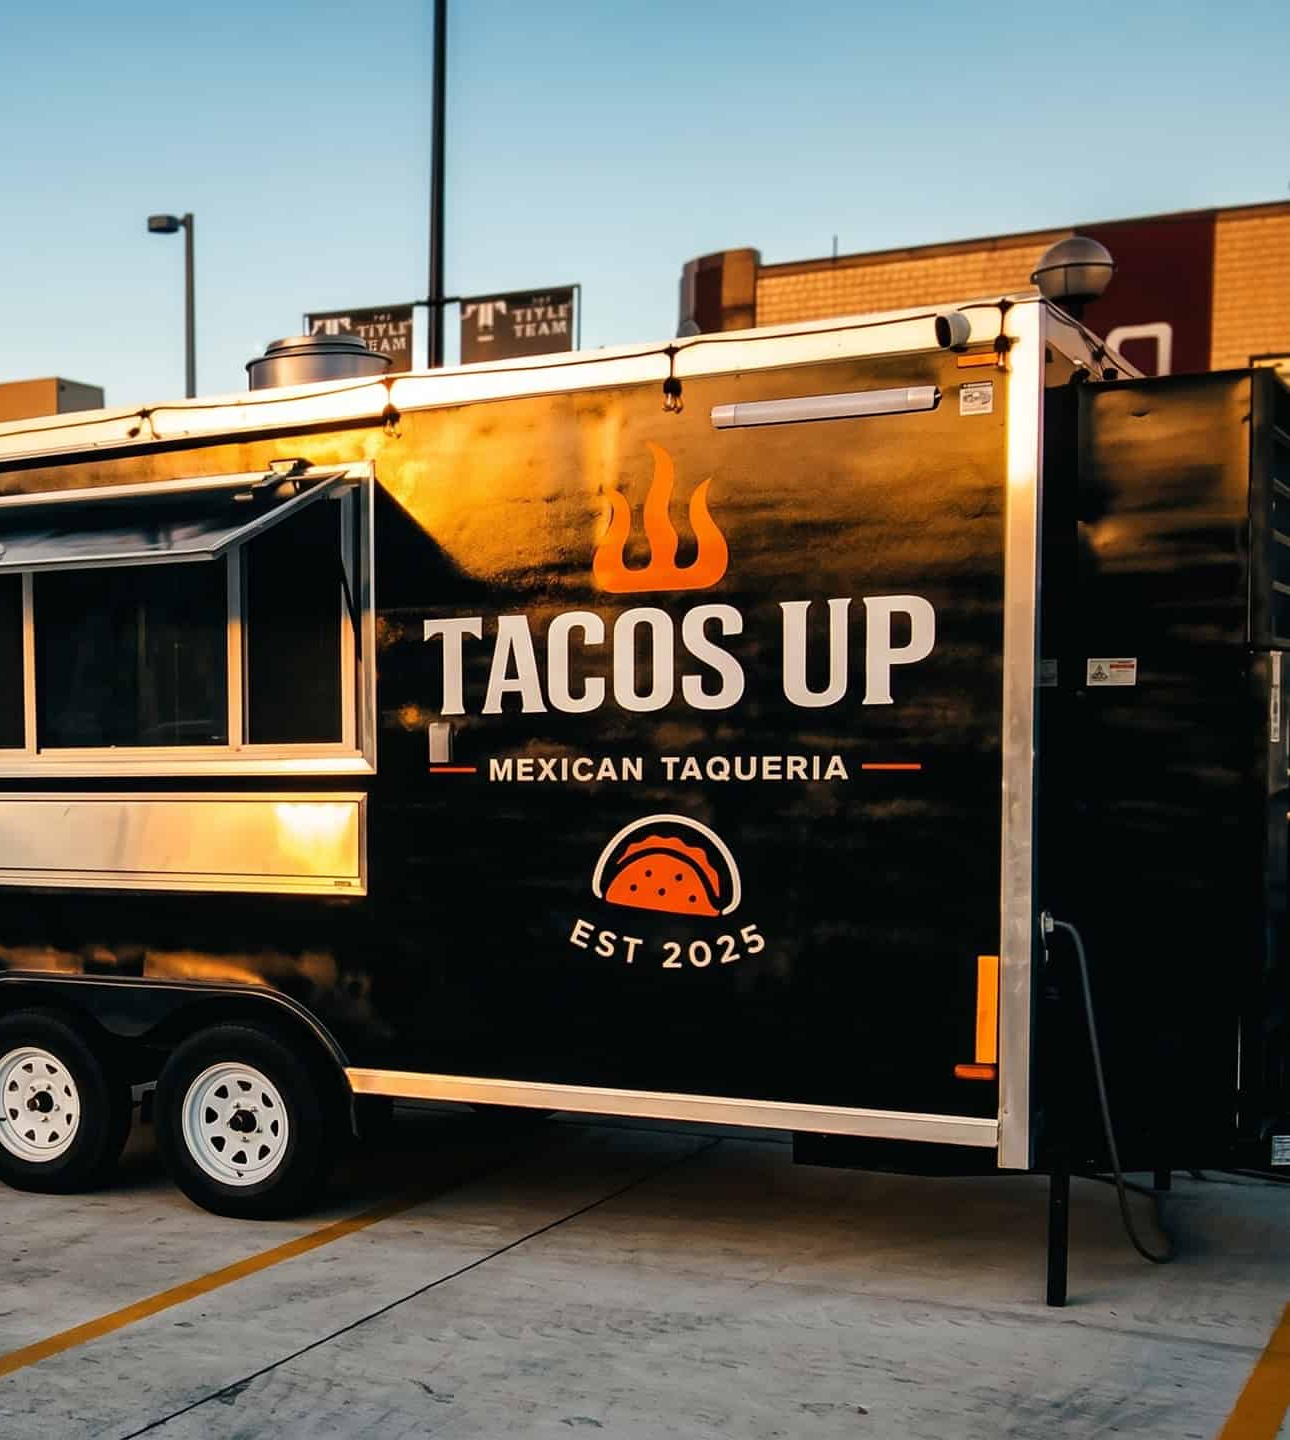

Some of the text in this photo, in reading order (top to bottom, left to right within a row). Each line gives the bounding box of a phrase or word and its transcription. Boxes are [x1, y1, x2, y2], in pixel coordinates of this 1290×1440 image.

[511, 304, 568, 322] TITLE
[356, 320, 409, 338] TITLE
[513, 320, 566, 338] TEAM
[368, 337, 407, 352] EAM
[423, 594, 936, 716] TACOS UP
[489, 755, 849, 782] MEXICAN TAQUERIA
[569, 919, 766, 969] EST 2025
